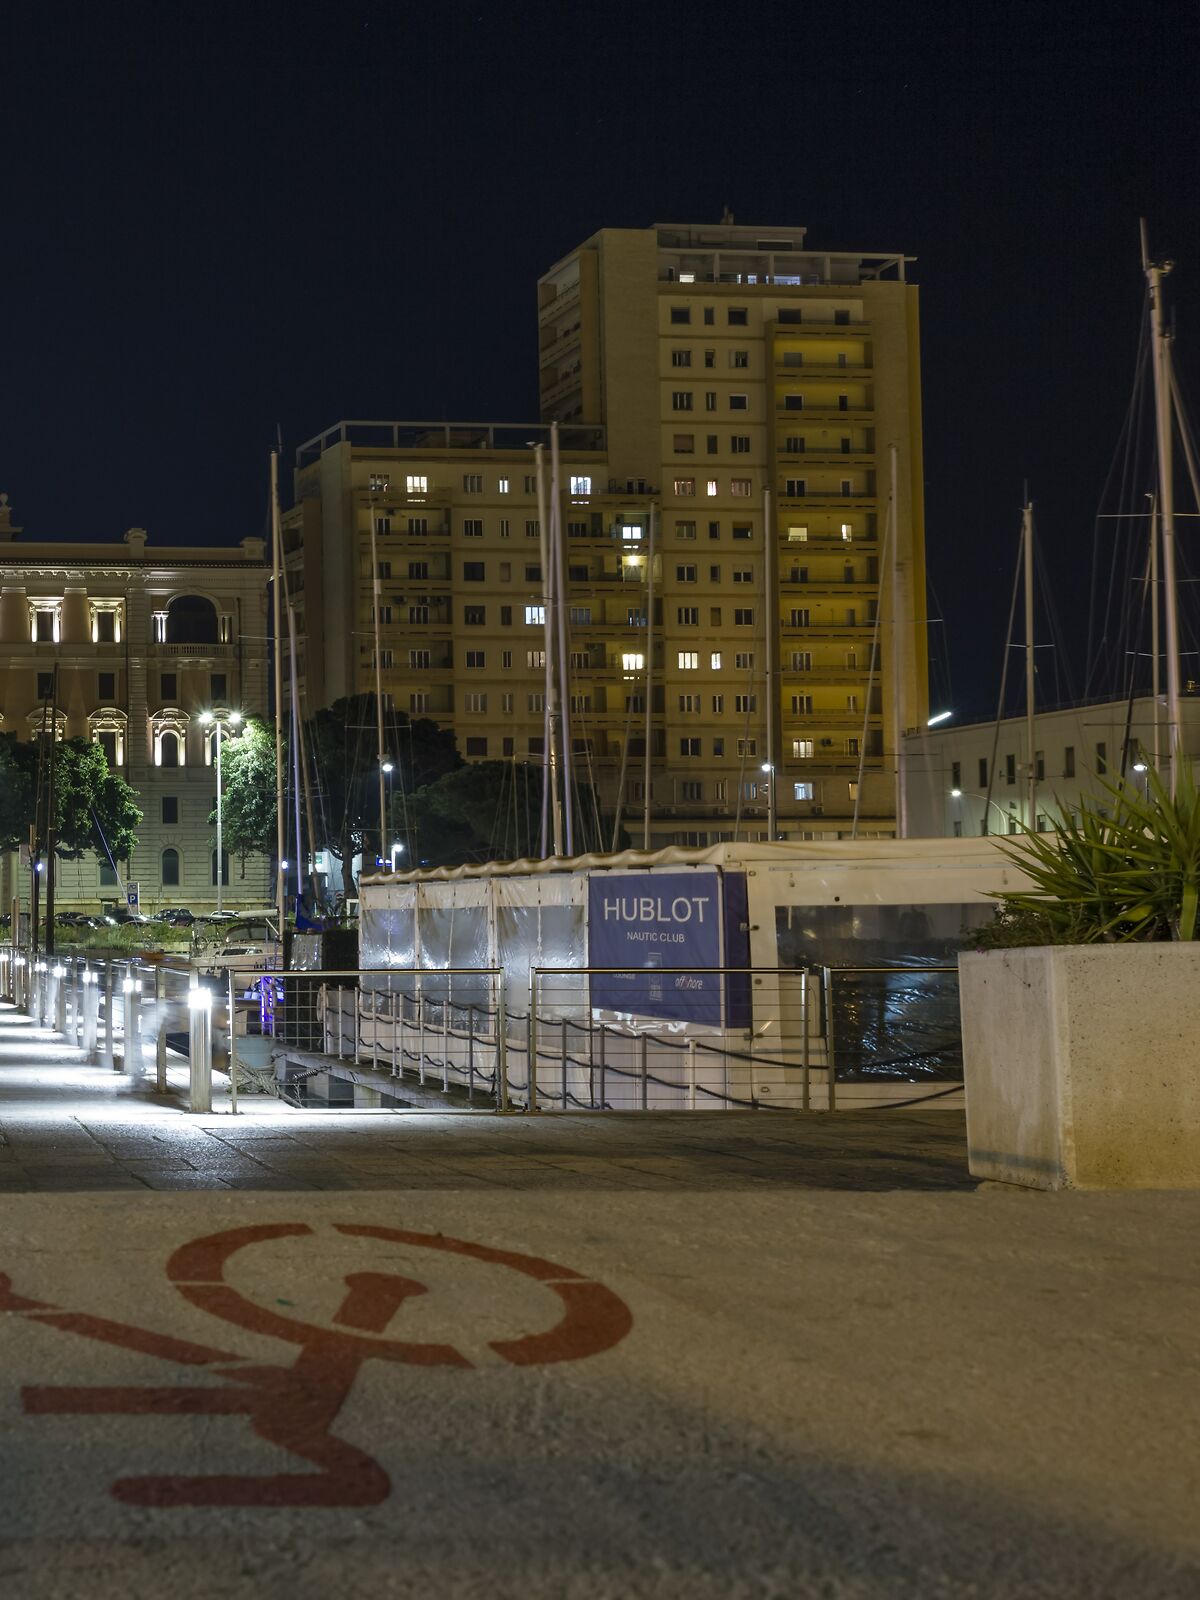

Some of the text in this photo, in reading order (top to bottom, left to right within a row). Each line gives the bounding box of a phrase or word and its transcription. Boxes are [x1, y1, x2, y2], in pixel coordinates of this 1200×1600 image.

[129, 895, 136, 903] P
[604, 897, 709, 923] HUBLOT
[627, 932, 685, 943] NAUTIC CLUB
